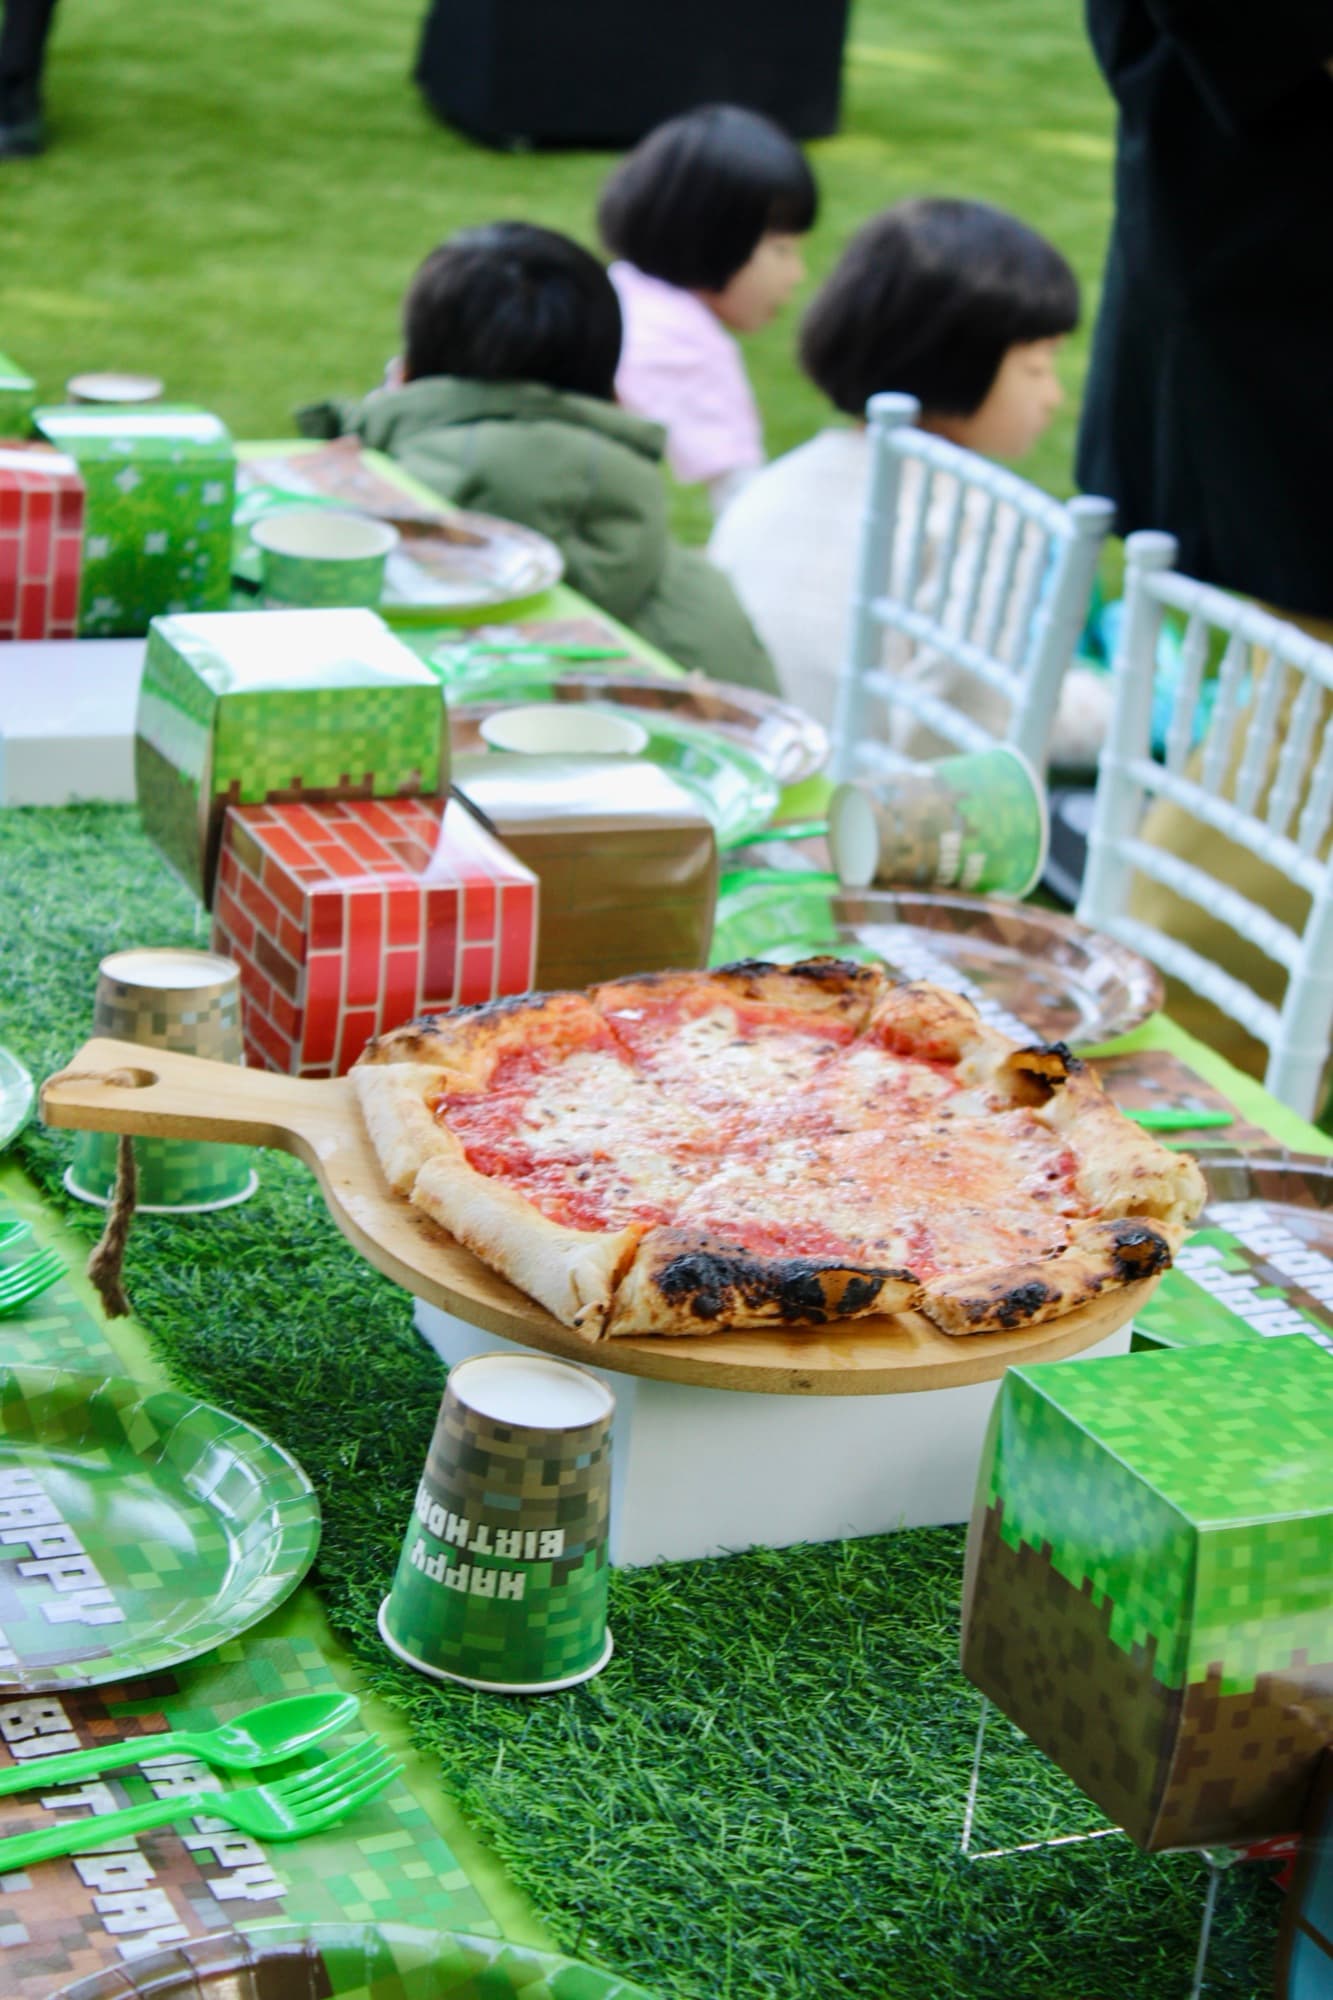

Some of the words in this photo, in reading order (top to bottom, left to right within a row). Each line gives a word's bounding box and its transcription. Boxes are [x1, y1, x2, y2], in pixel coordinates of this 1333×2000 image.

[1173, 1246, 1333, 1356] APPY
[413, 1486, 565, 1560] BIRTHDA
[410, 1538, 526, 1601] HAPPY
